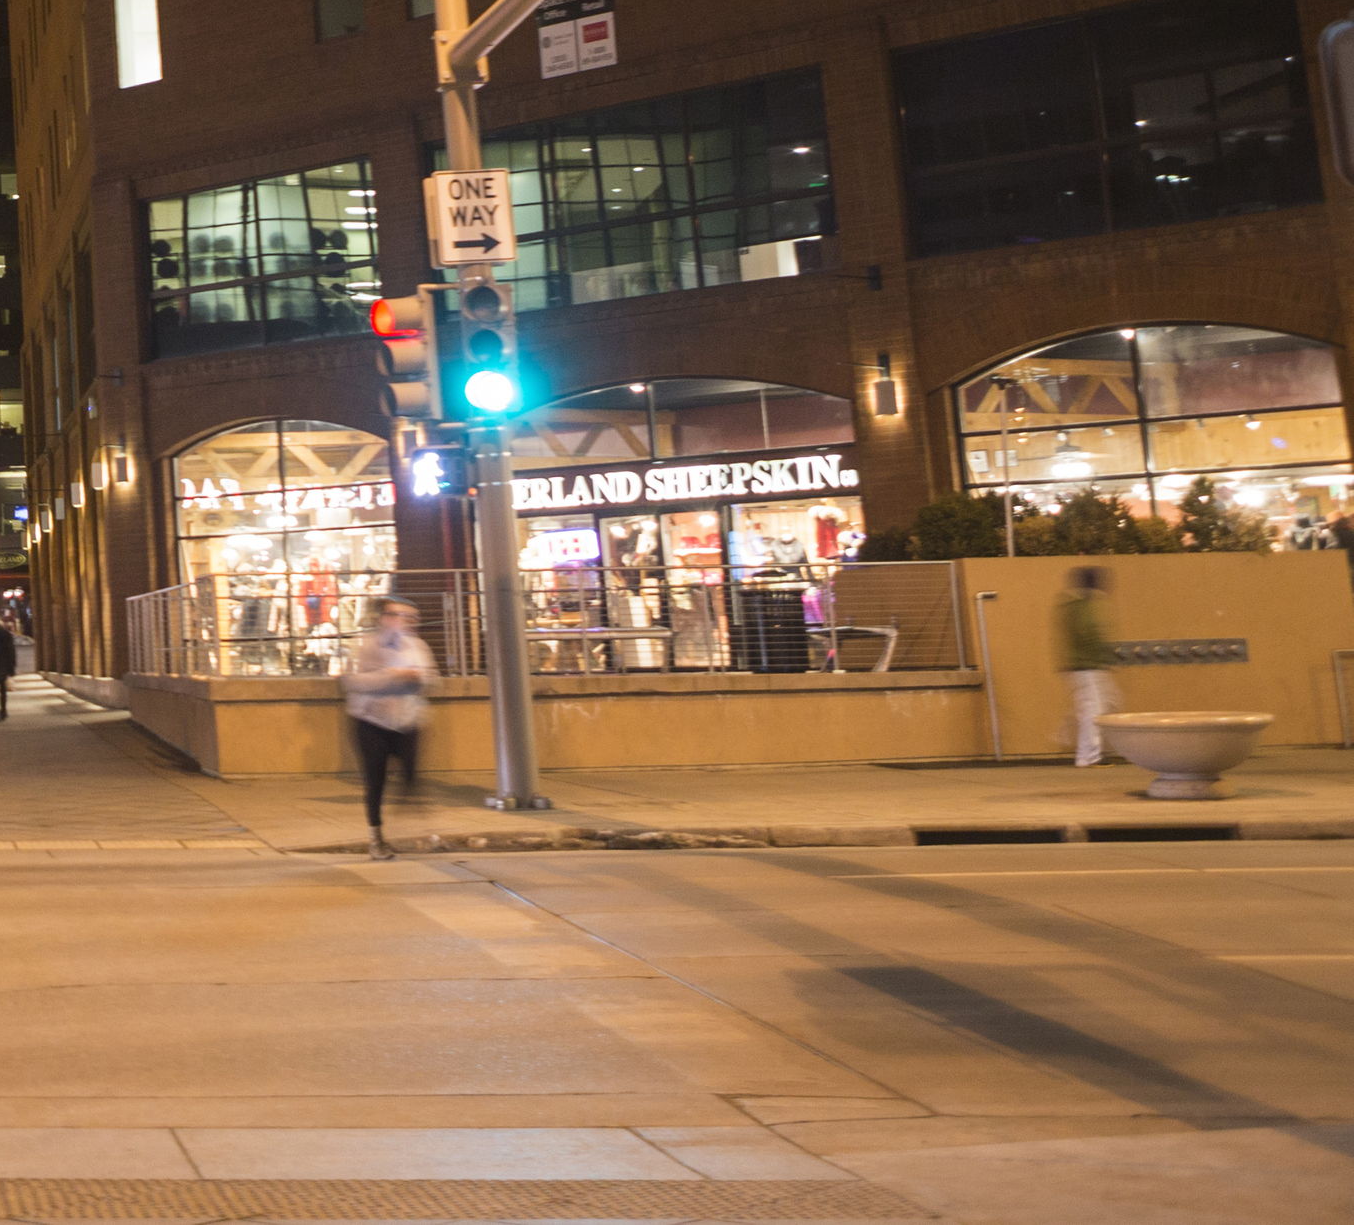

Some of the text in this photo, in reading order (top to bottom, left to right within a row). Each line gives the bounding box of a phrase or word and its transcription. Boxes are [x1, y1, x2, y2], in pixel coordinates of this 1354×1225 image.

[448, 178, 497, 201] ONE
[448, 204, 500, 227] WAY
[645, 454, 842, 502] SHEEPSKIN
